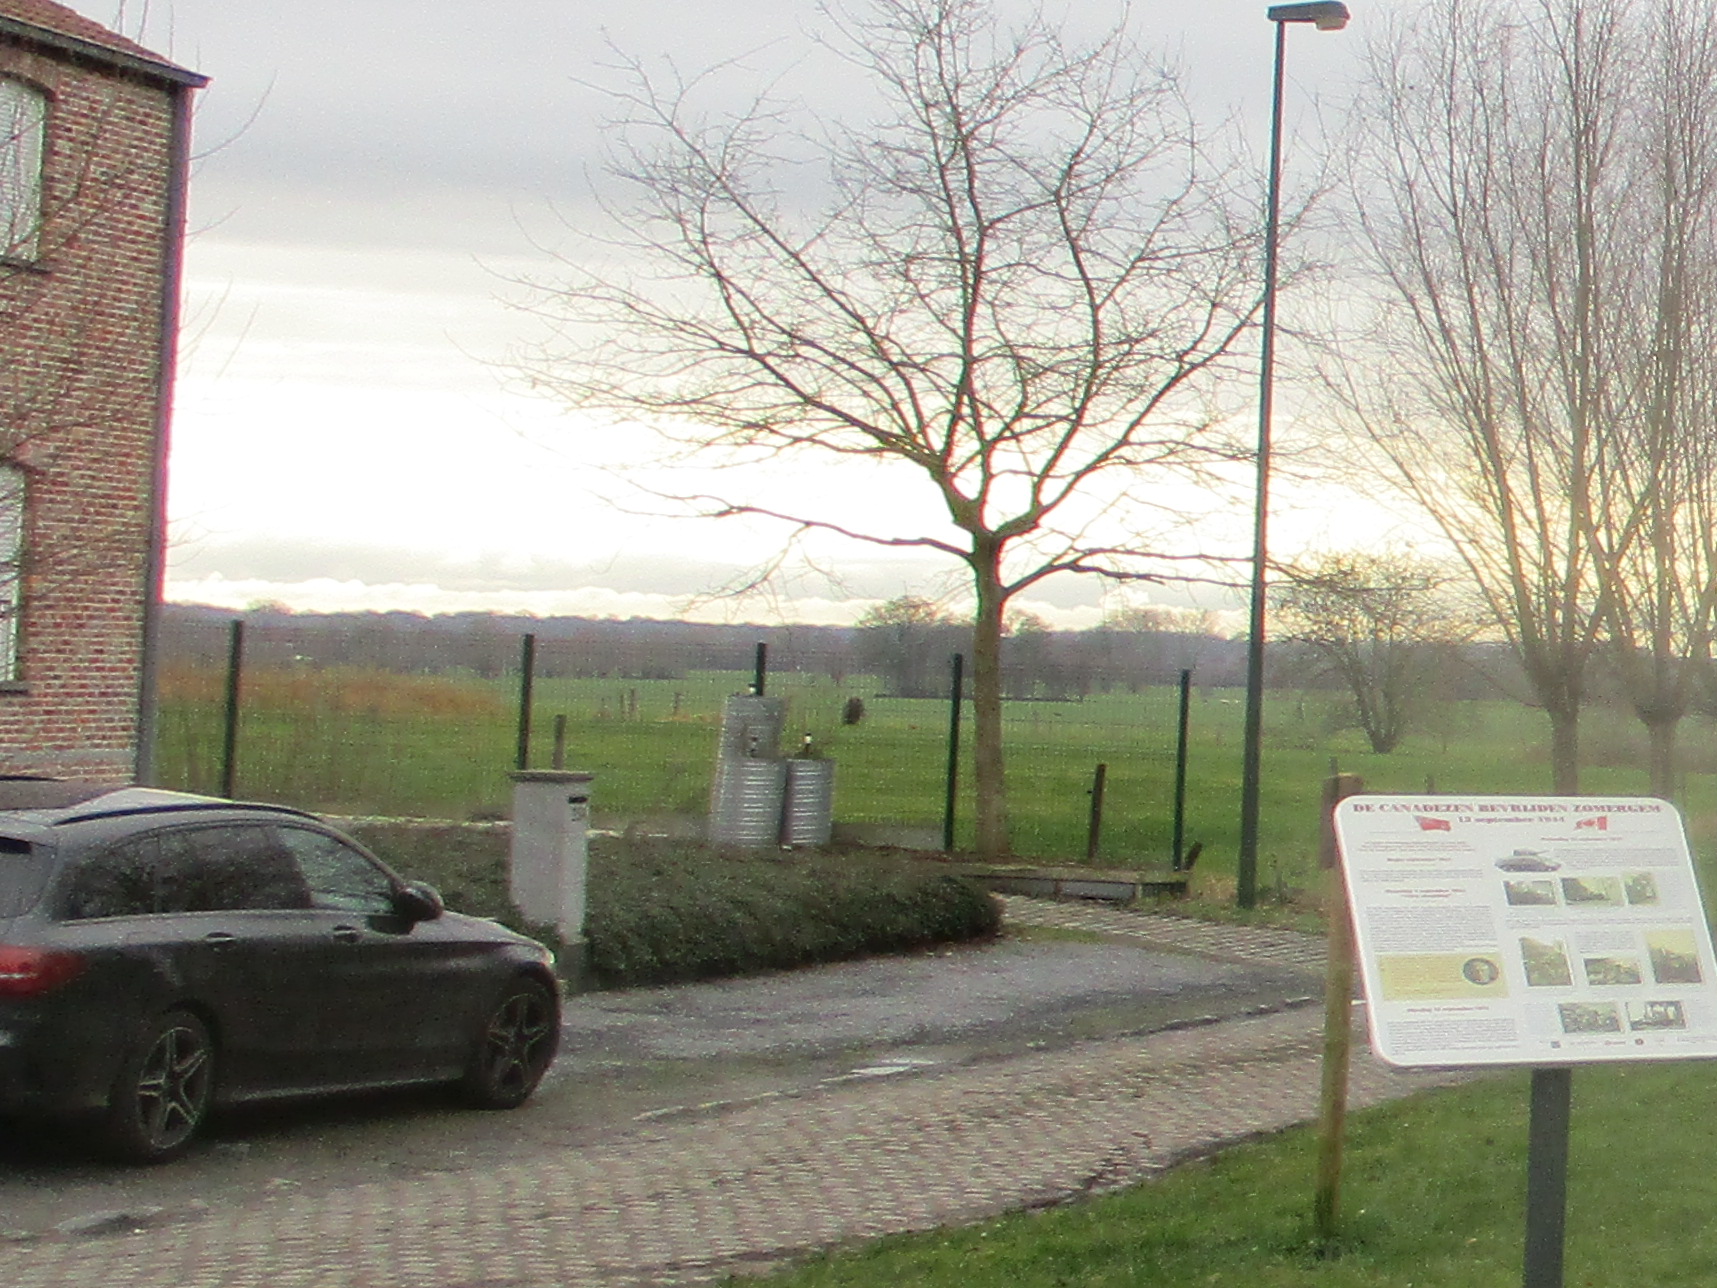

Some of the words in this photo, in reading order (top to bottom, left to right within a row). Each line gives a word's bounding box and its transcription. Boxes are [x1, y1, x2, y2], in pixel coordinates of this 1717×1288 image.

[1353, 803, 1375, 812] DE
[1379, 803, 1474, 813] CANADEZEN
[1478, 803, 1568, 813] BEVRIJDEN
[1574, 804, 1662, 813] ZOMERGEM
